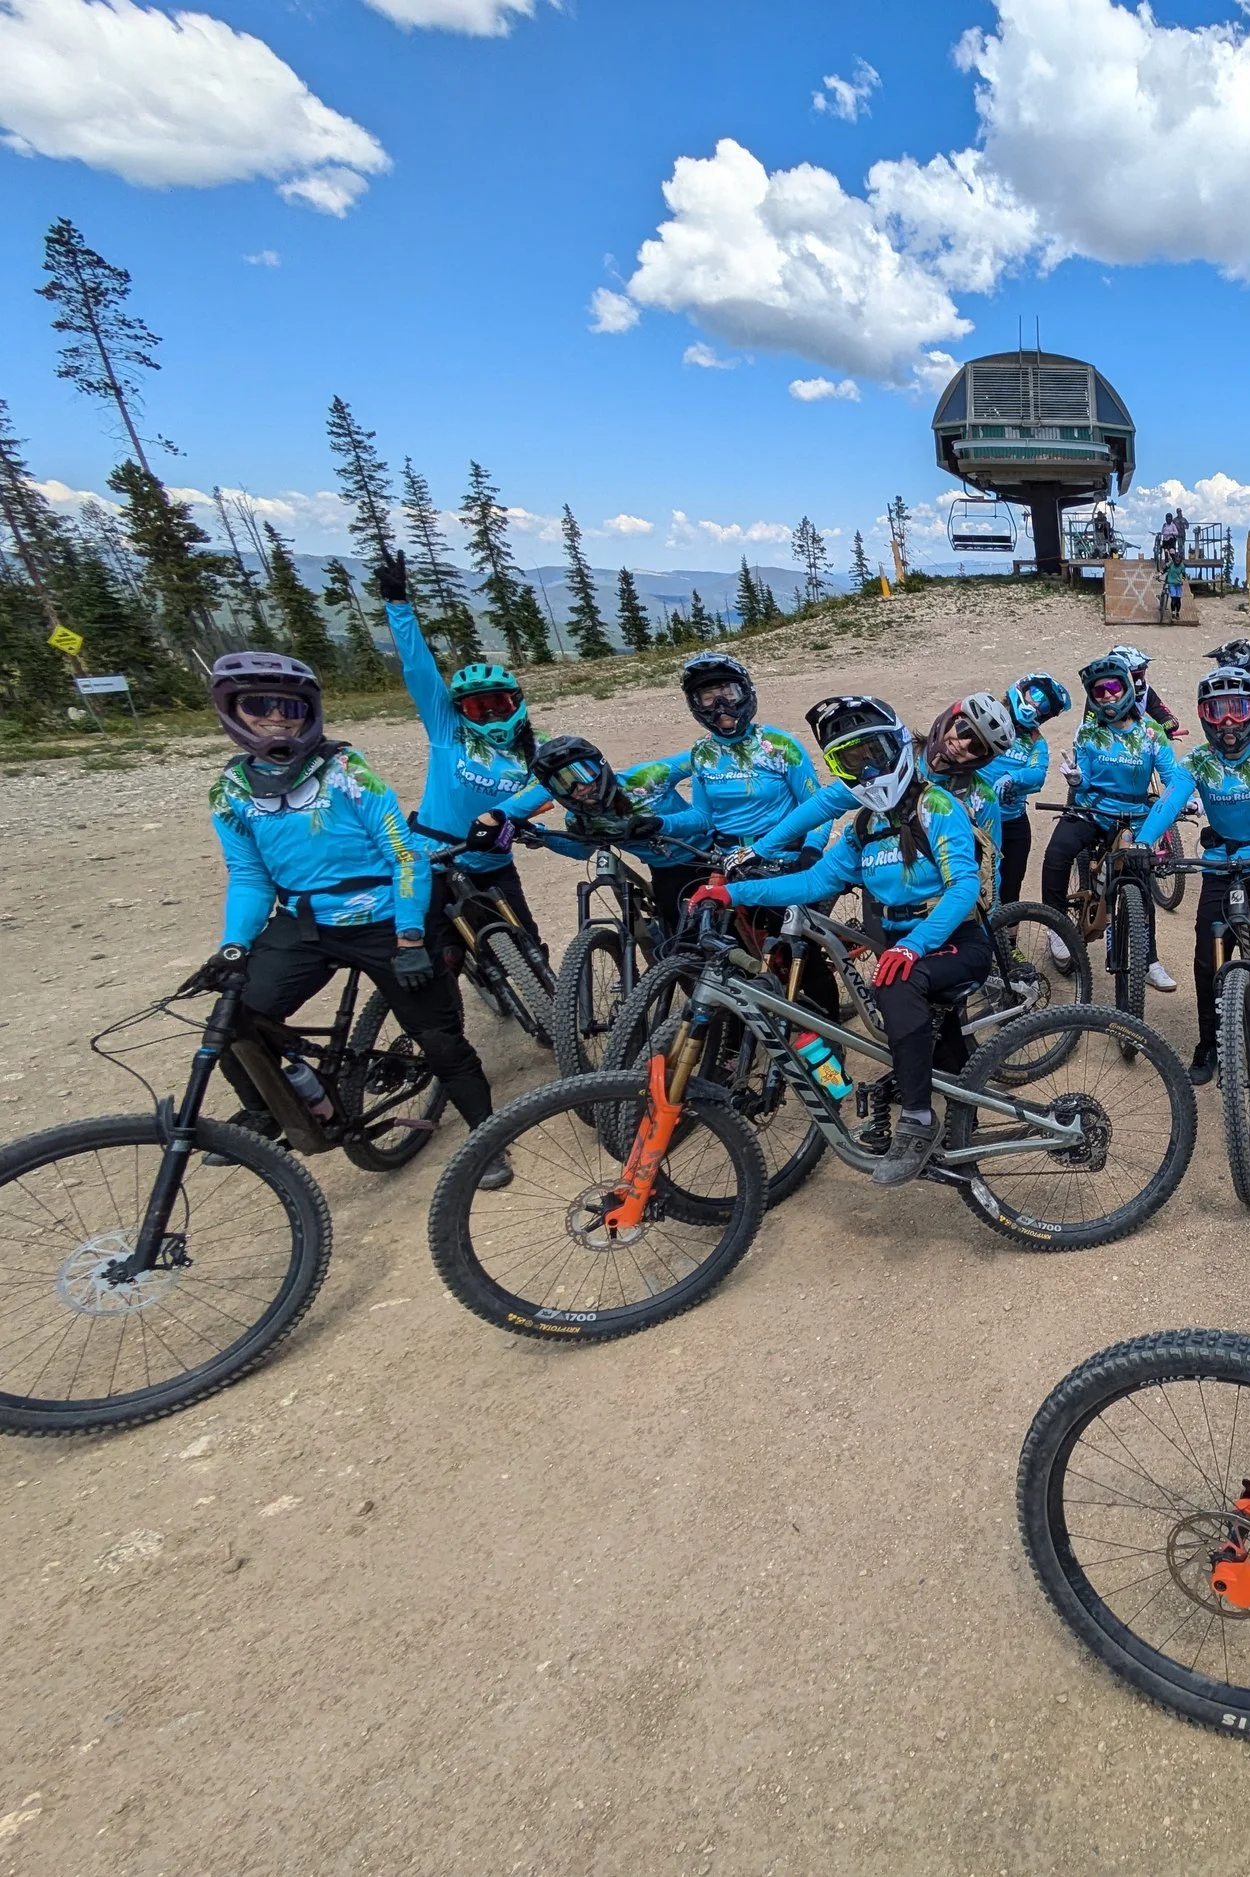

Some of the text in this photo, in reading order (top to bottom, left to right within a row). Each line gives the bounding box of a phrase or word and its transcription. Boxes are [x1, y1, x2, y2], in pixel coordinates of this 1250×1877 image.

[457, 759, 495, 787] Flow
[1037, 1221, 1062, 1232] 1700
[564, 1312, 597, 1322] 1700
